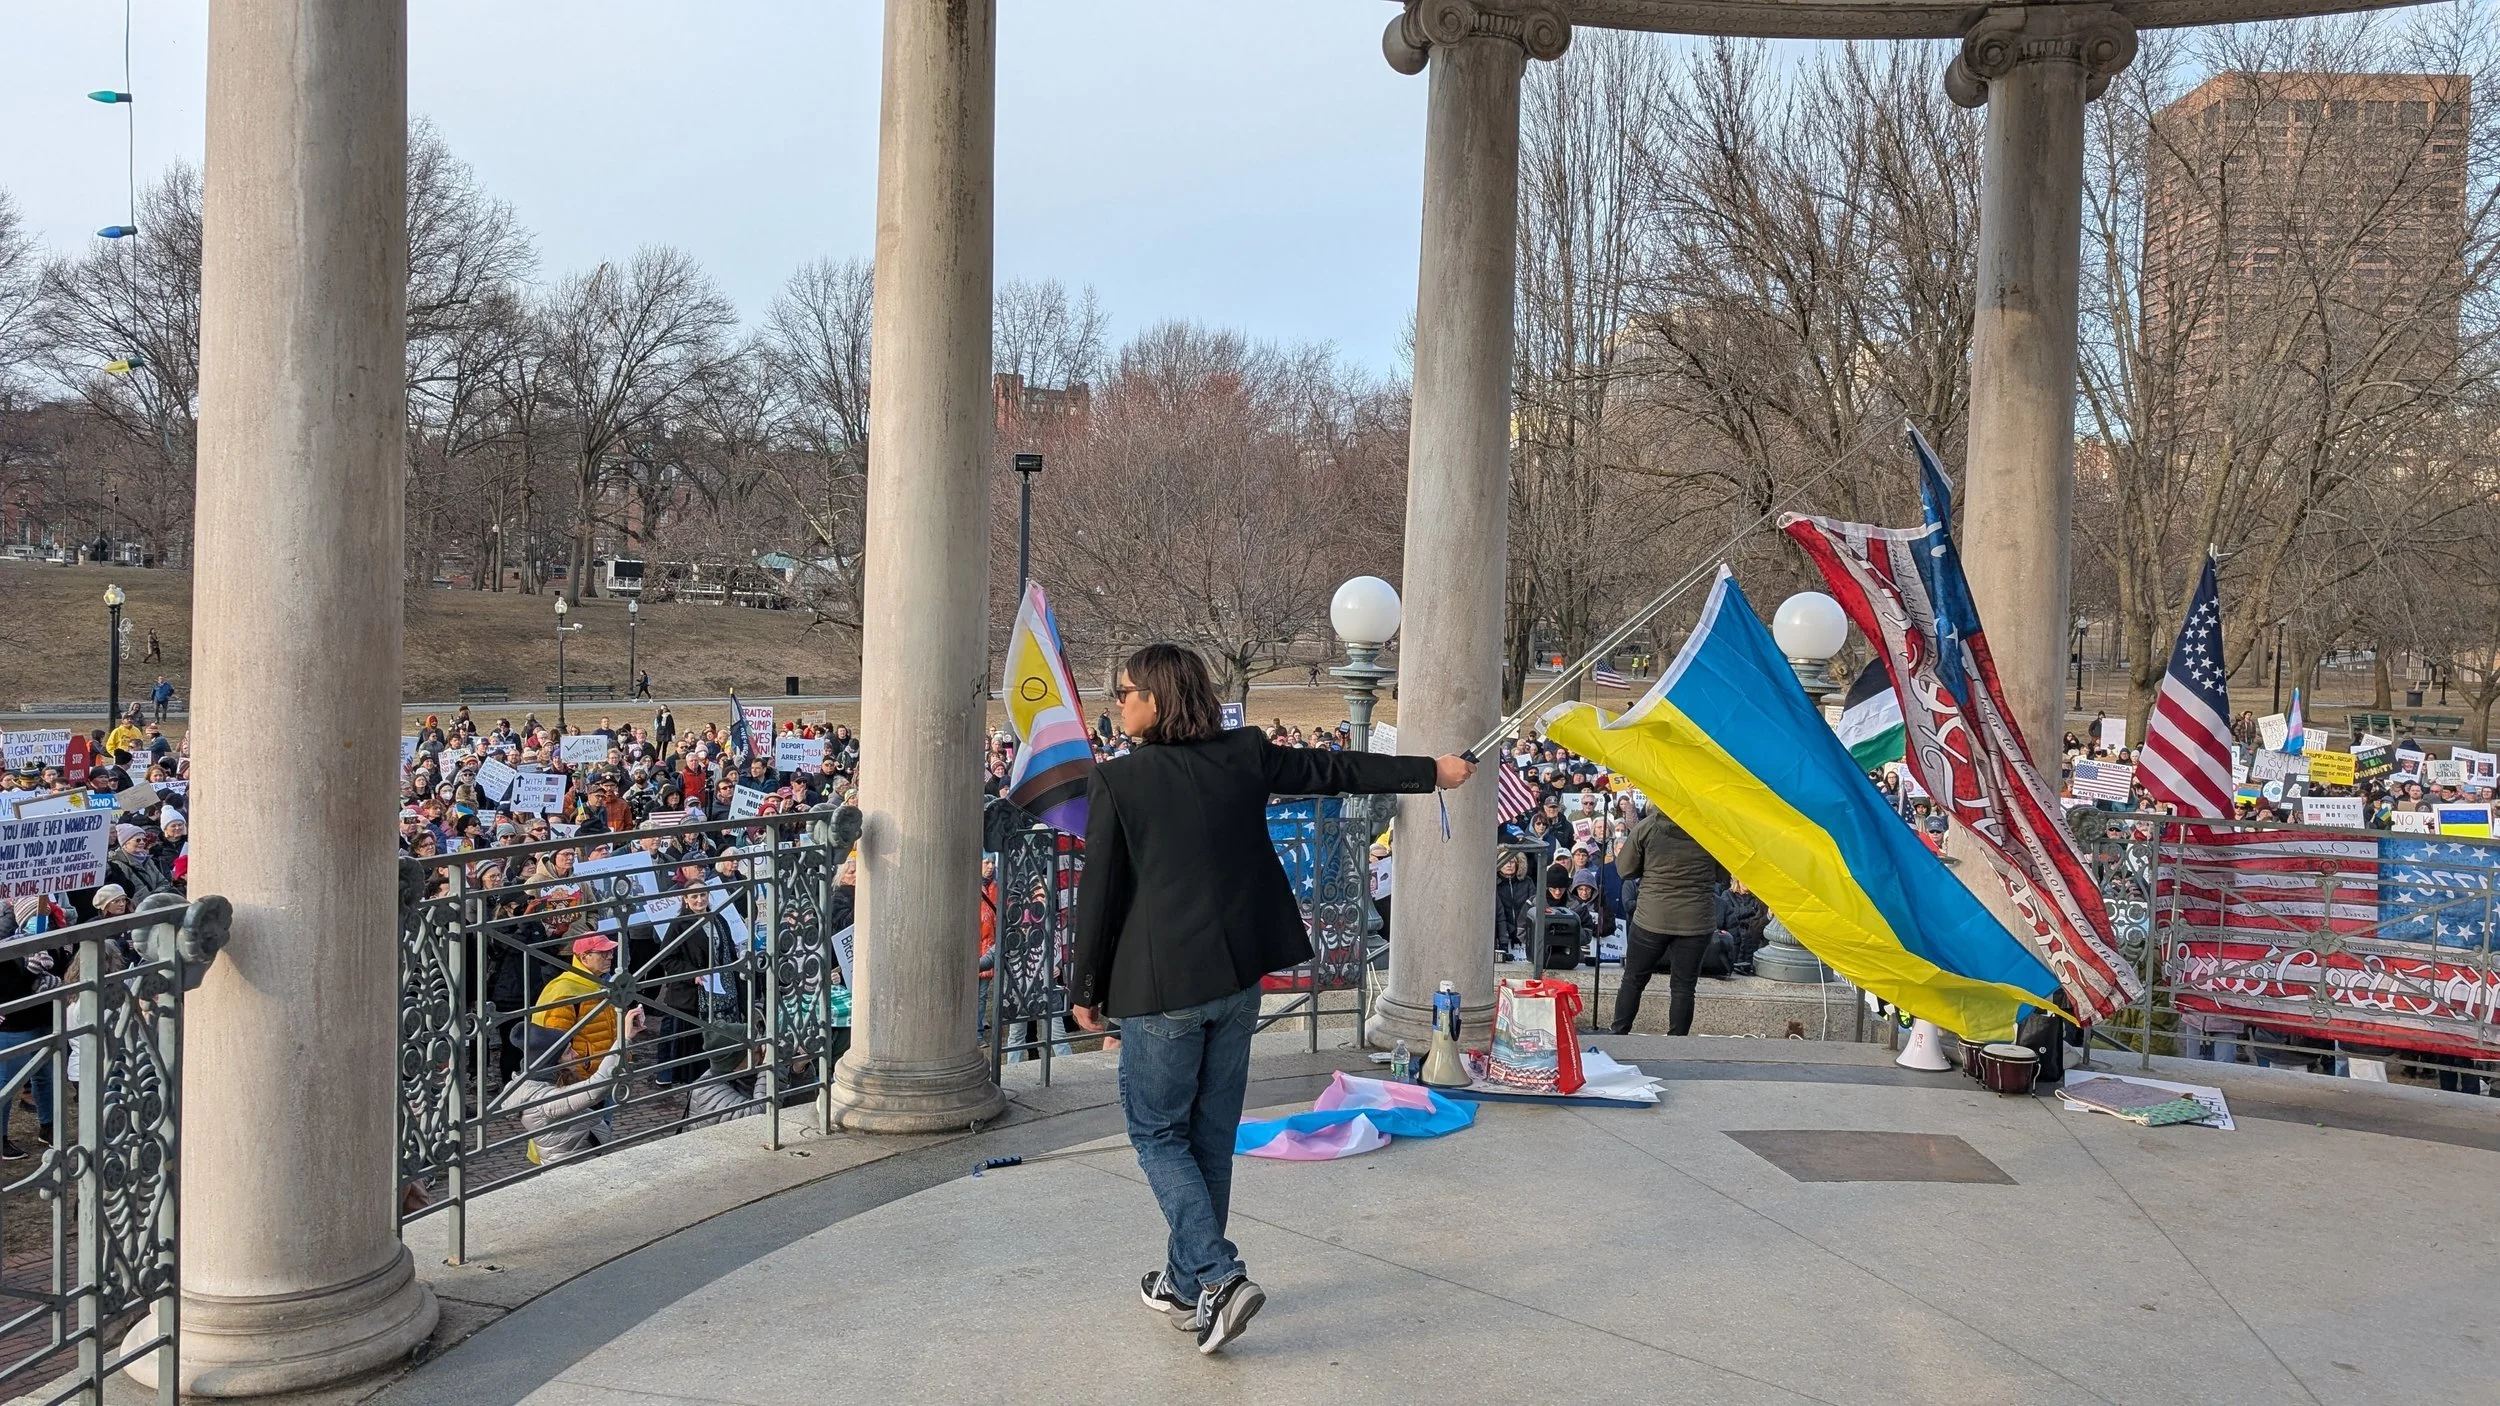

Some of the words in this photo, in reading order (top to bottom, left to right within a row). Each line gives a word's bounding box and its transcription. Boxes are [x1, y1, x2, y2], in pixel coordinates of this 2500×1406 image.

[748, 720, 772, 731] RUMP
[781, 742, 805, 750] DEPORT
[72, 753, 83, 765] STOP
[781, 754, 806, 762] ARREST
[2079, 759, 2131, 772] PRO-AMERICA
[2012, 759, 2042, 794] form
[2077, 790, 2124, 801] ANTI-TRUMP
[2, 823, 19, 840] YOU
[20, 821, 41, 838] HAVE
[43, 819, 62, 837] EVER
[64, 814, 103, 834] WONDERED
[2395, 814, 2414, 826] NO
[0, 843, 21, 861] WHAT
[46, 839, 57, 856] DO
[59, 835, 88, 855] DURING
[33, 857, 48, 869] THE
[51, 851, 92, 866] HOLOCAUST
[6, 870, 28, 880] CIVIL
[32, 866, 60, 877] RIGHTS
[64, 860, 98, 873] MOVEMENT
[15, 879, 39, 898] DOING
[42, 877, 53, 894] IT
[55, 873, 78, 892] RIGHT
[81, 871, 97, 888] NOW
[648, 896, 682, 914] RESIS
[2019, 826, 2066, 901] common
[2070, 911, 2131, 988] defense,
